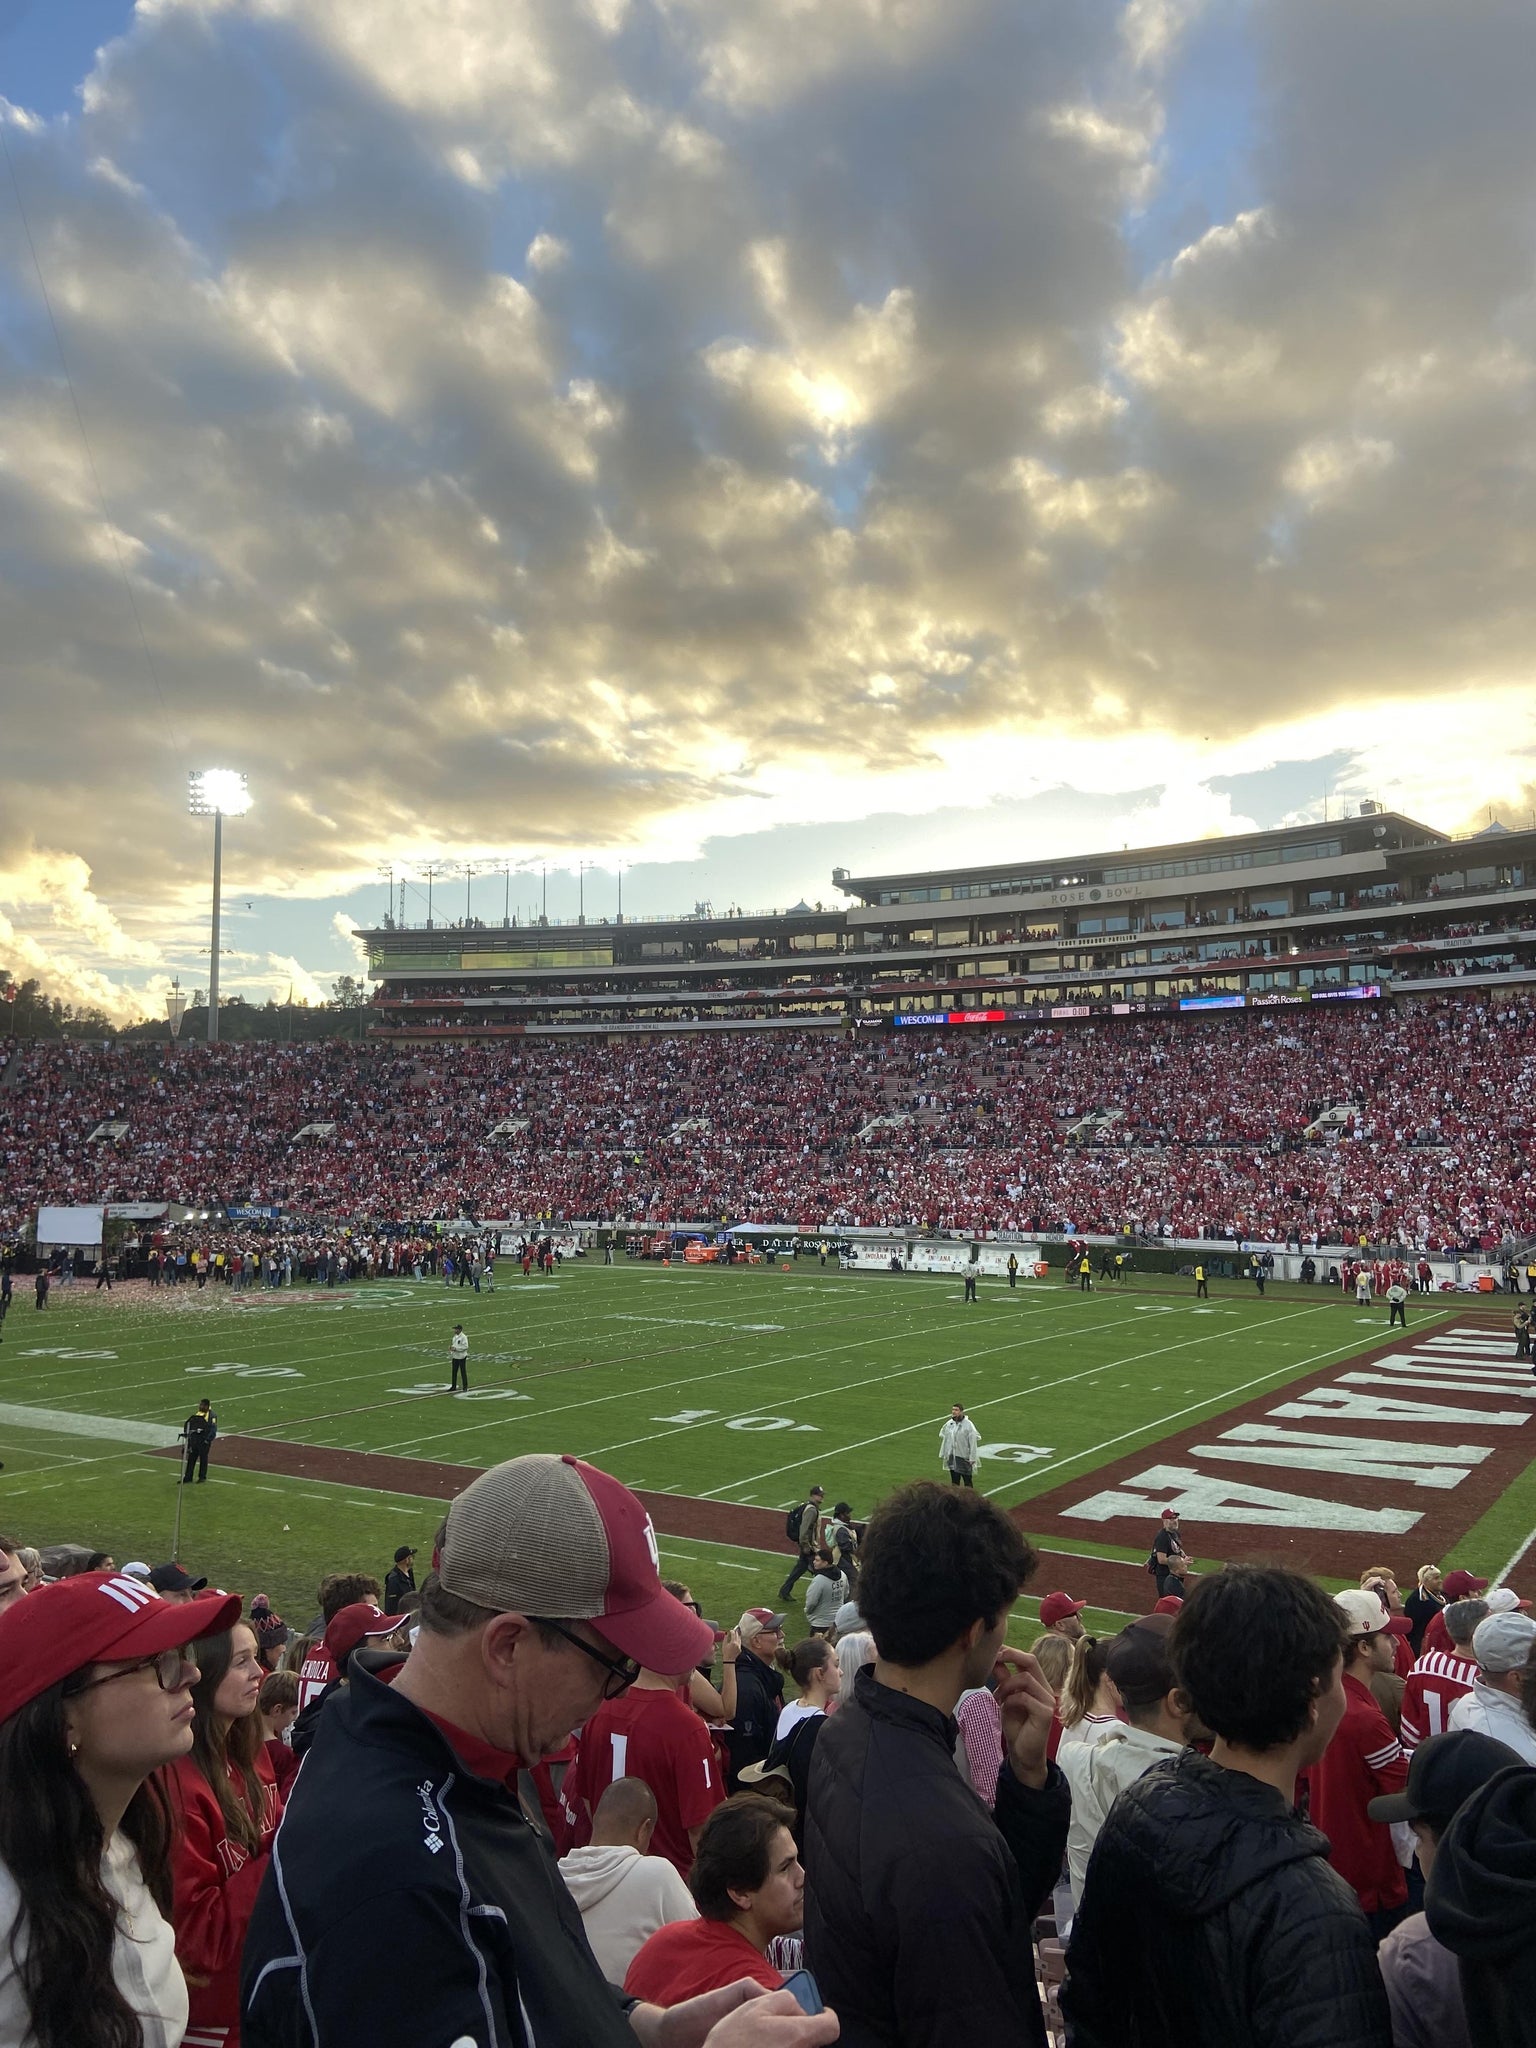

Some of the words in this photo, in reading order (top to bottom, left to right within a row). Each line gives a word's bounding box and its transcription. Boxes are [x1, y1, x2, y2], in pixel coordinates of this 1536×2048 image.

[1051, 892, 1085, 904] ROSE
[1106, 886, 1142, 898] BOWL
[1443, 938, 1473, 948] TRADITION
[1252, 997, 1280, 1006] Passion
[1280, 995, 1303, 1004] Roses
[1136, 1003, 1146, 1012] 38
[1038, 1009, 1044, 1018] 3
[900, 1015, 935, 1024] WESCOM
[236, 1208, 262, 1216] WESCOM
[997, 1231, 1023, 1241] TRADITION
[1045, 1233, 1065, 1241] HONOR
[864, 1252, 888, 1260] INDIANA
[1035, 1264, 1042, 1272] G
[649, 1409, 796, 1432] 10
[977, 1442, 1057, 1464] G
[702, 1758, 712, 1789] 1
[416, 1780, 441, 1832] Columbia
